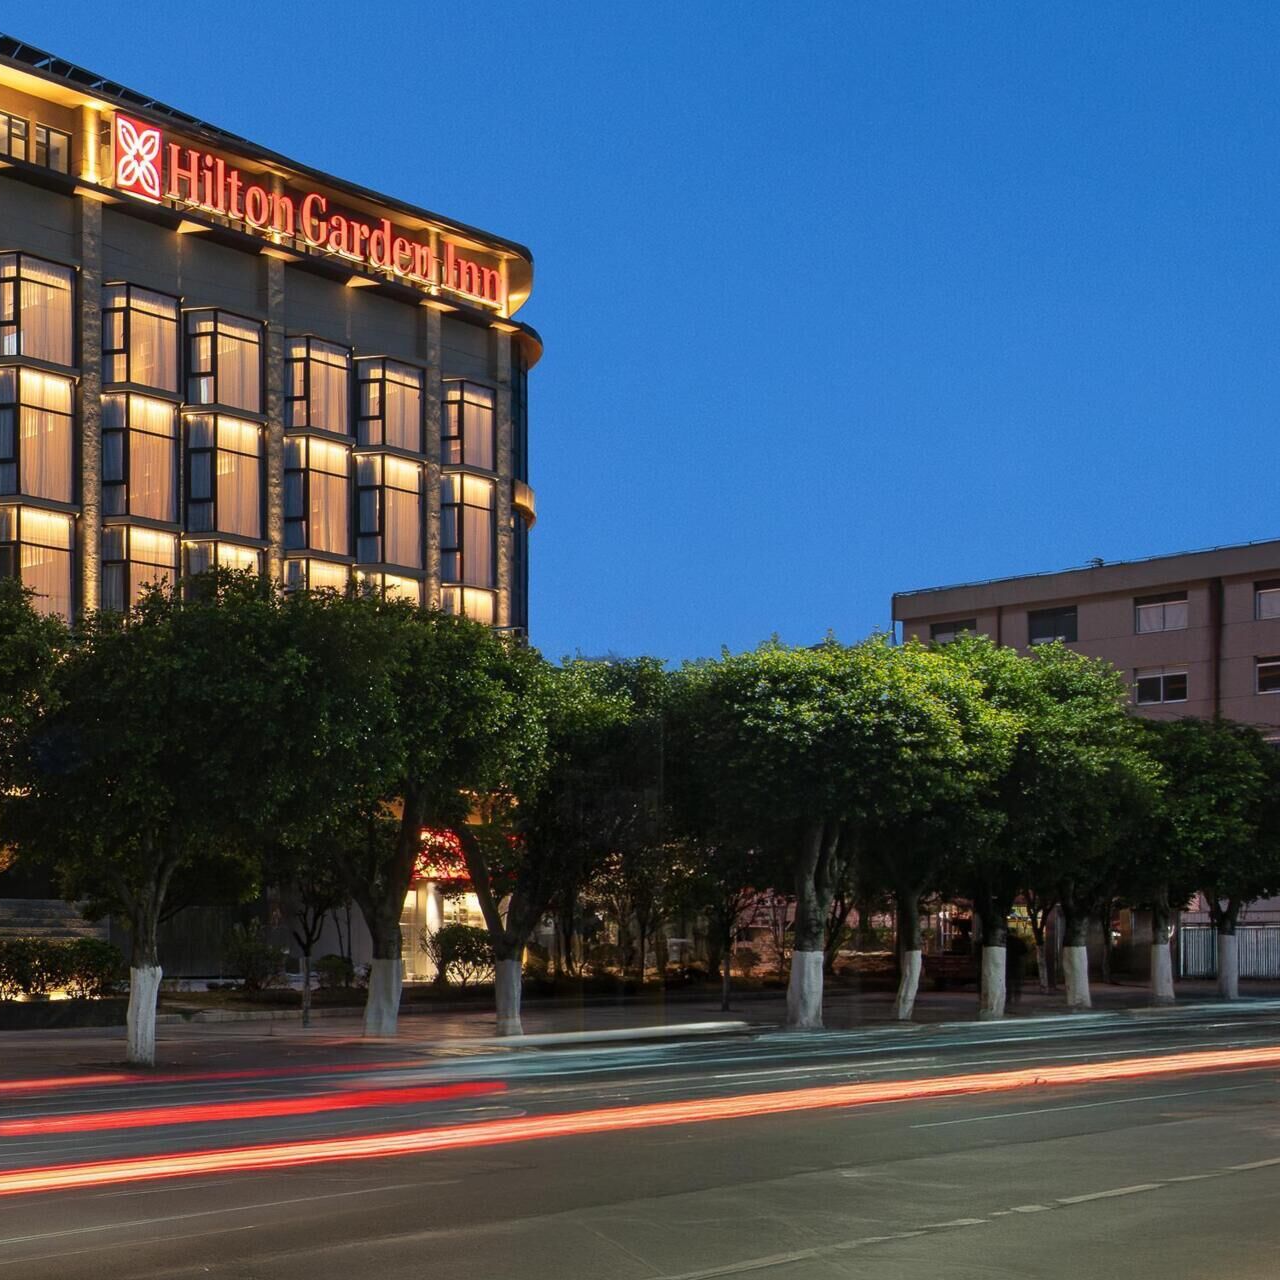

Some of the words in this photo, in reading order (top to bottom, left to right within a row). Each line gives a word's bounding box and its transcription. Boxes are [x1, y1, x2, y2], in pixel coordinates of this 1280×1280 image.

[167, 143, 295, 237] Hilton
[301, 193, 434, 283] Garden
[444, 242, 506, 308] Inn
